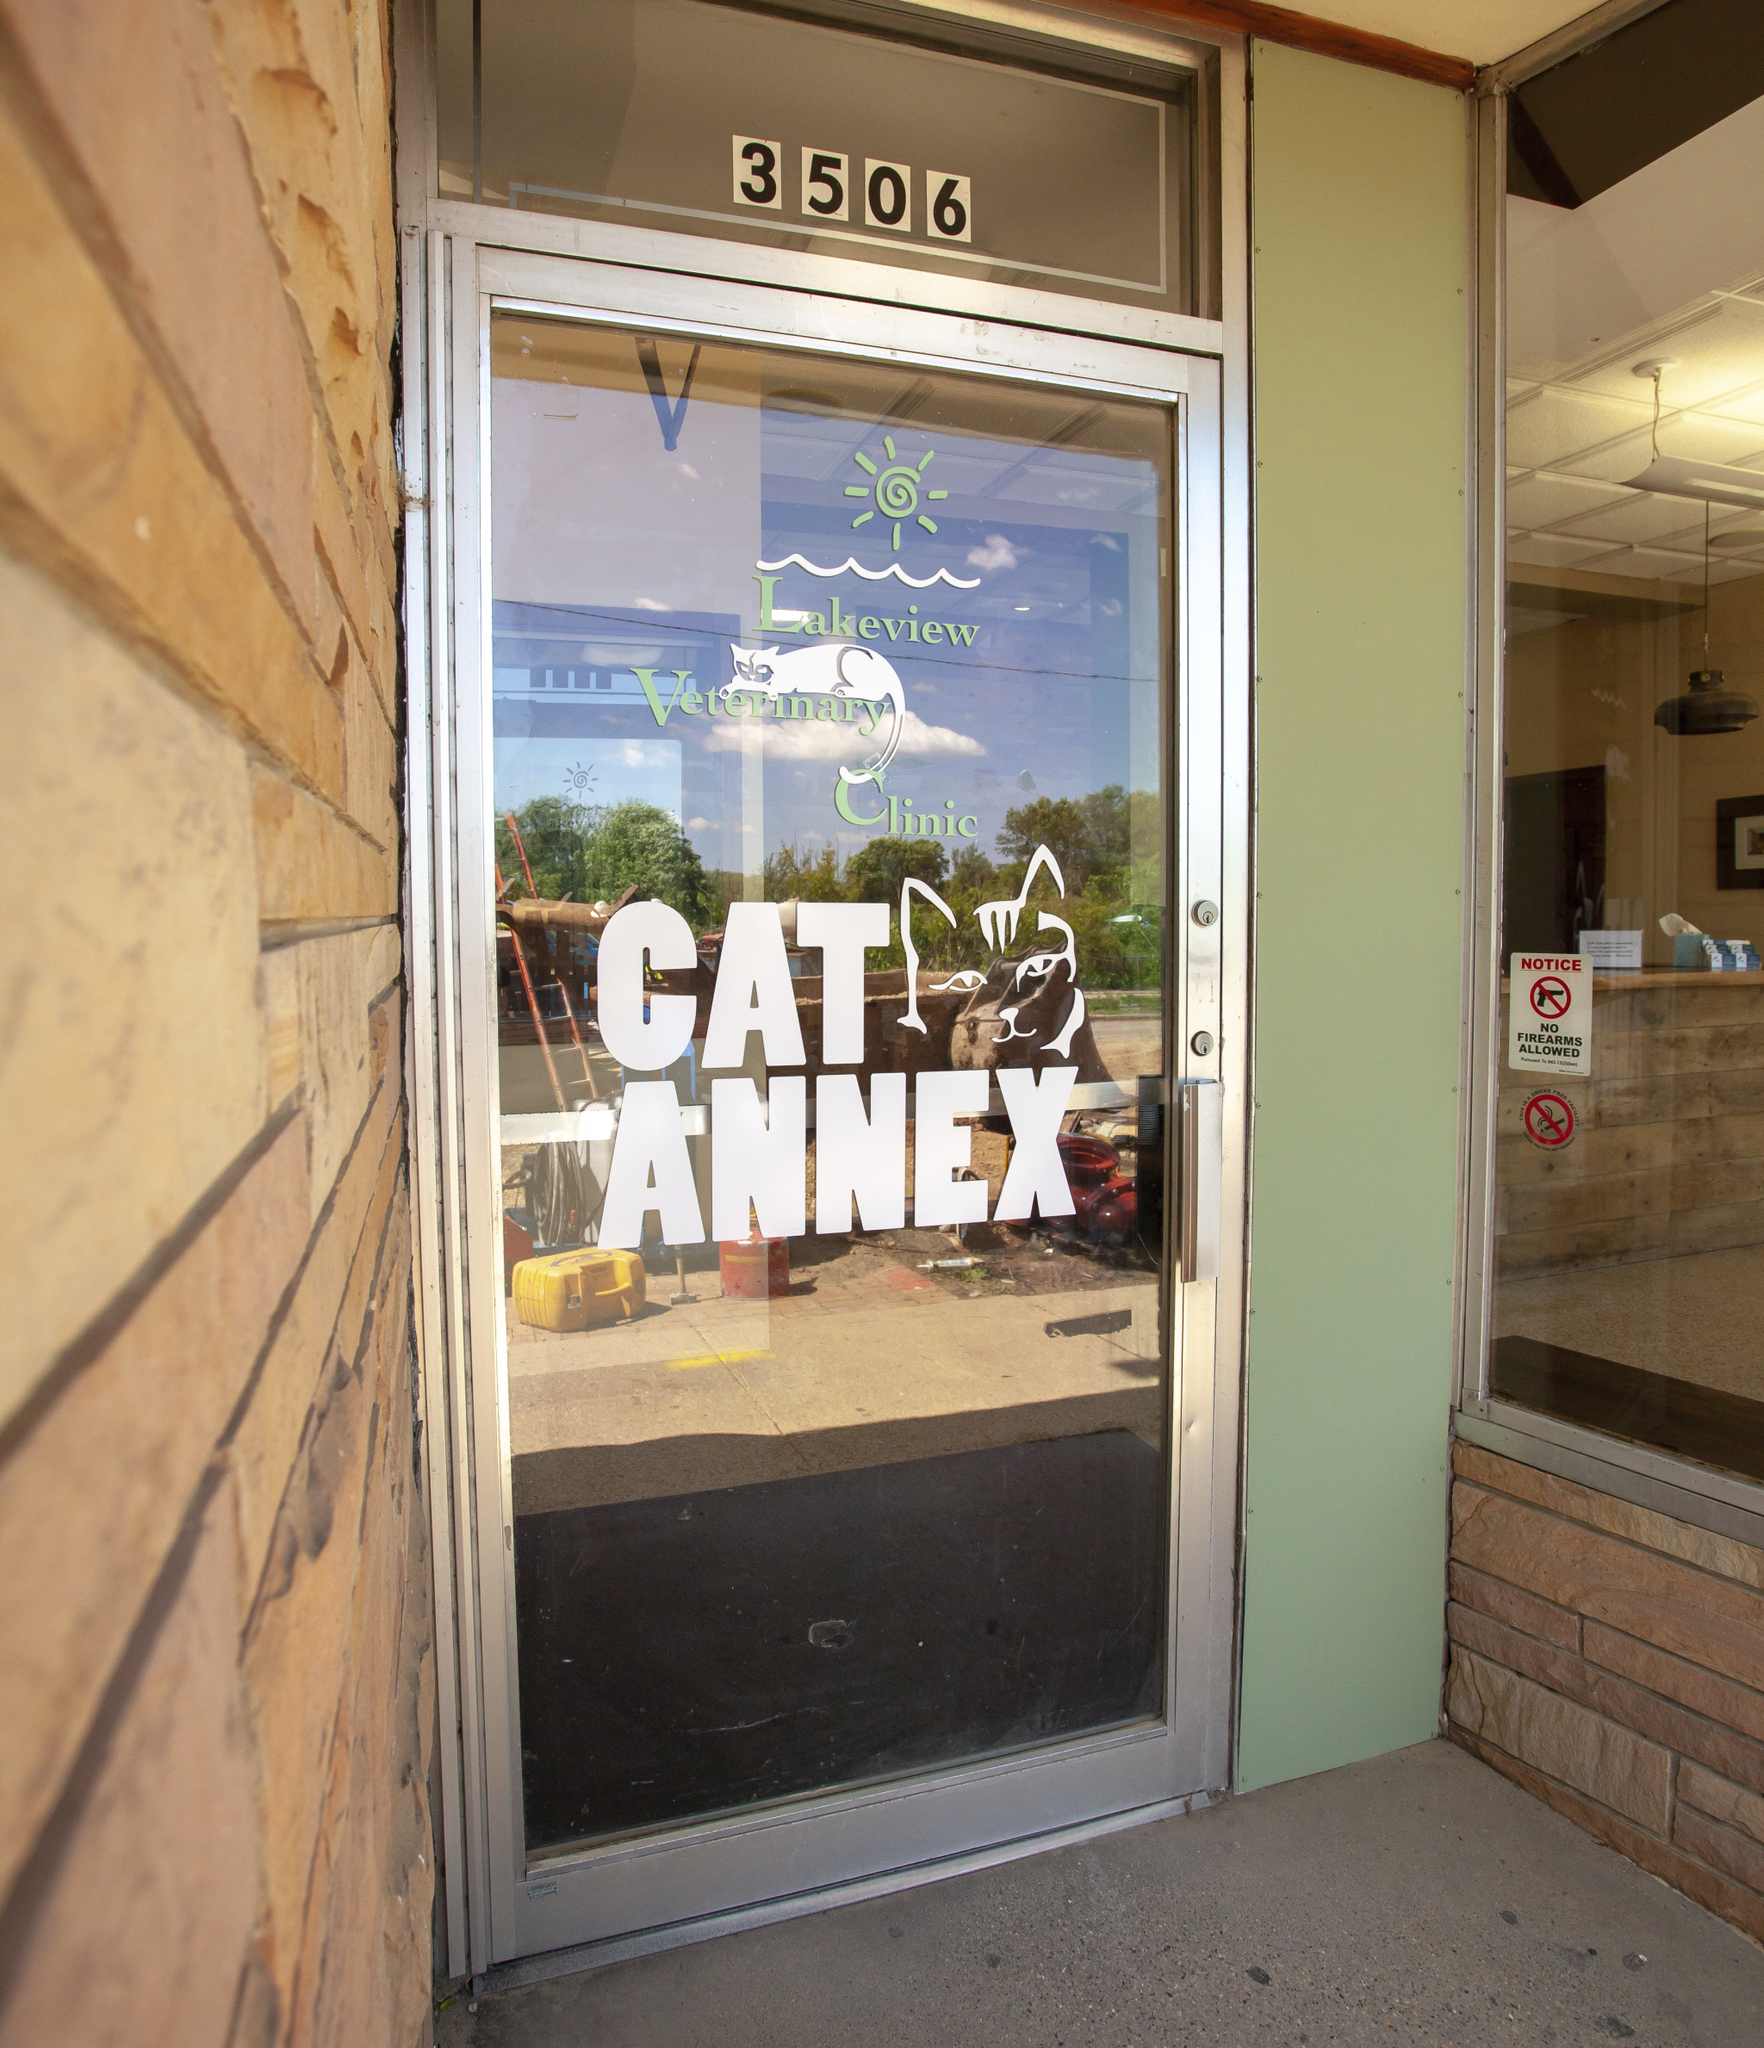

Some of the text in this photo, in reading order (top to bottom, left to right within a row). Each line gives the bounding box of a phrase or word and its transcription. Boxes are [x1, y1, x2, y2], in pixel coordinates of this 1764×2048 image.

[740, 142, 967, 236] 3506
[752, 575, 981, 647] Lakeview
[630, 667, 892, 735] Veterinary
[835, 769, 979, 838] Clinic
[597, 901, 890, 1071] CAT
[1521, 958, 1582, 971] NOTICE
[1517, 1032, 1583, 1047] FIREARMS
[1518, 1044, 1580, 1058] ALLOWED
[1540, 1023, 1559, 1033] NO
[597, 1066, 1079, 1249] ANNEX
